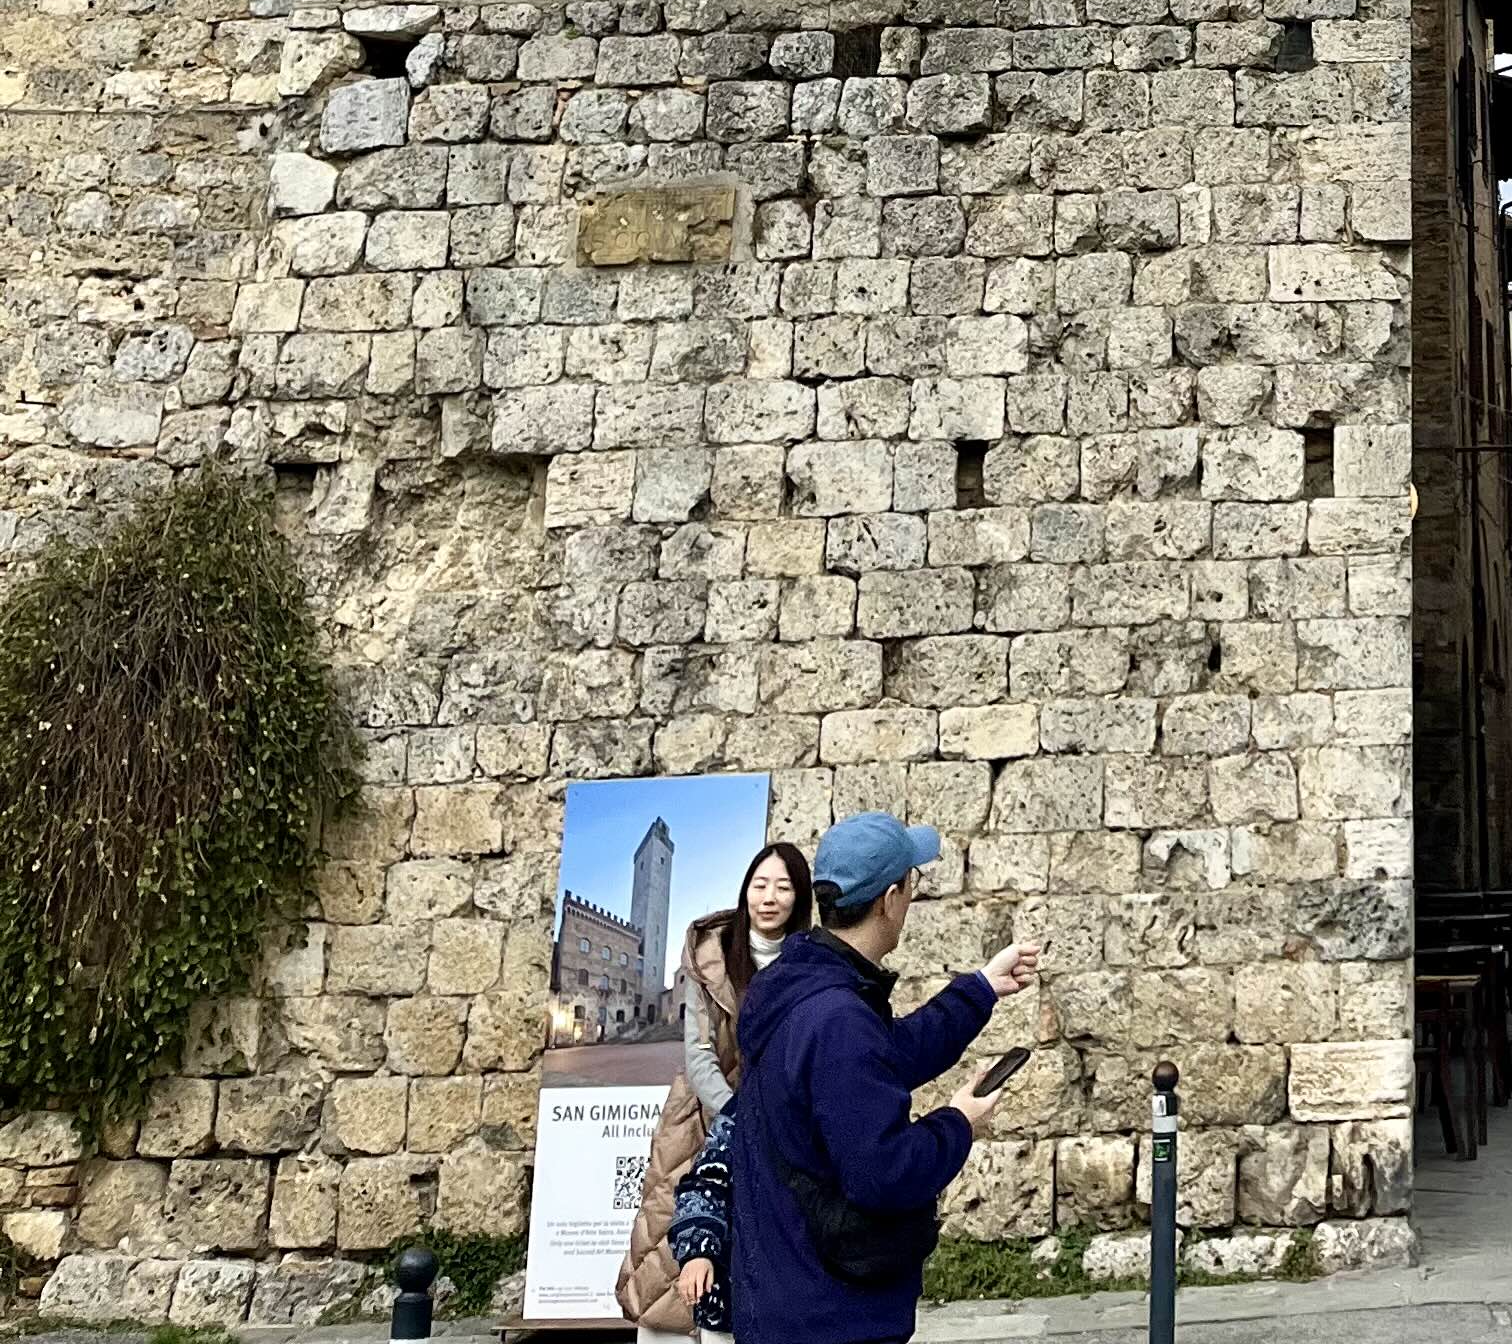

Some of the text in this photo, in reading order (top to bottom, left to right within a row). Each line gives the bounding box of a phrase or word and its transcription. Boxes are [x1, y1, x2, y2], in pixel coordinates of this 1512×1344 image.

[552, 1104, 661, 1121] SAN GIMIGNA
[602, 1123, 655, 1138] All Inclu
